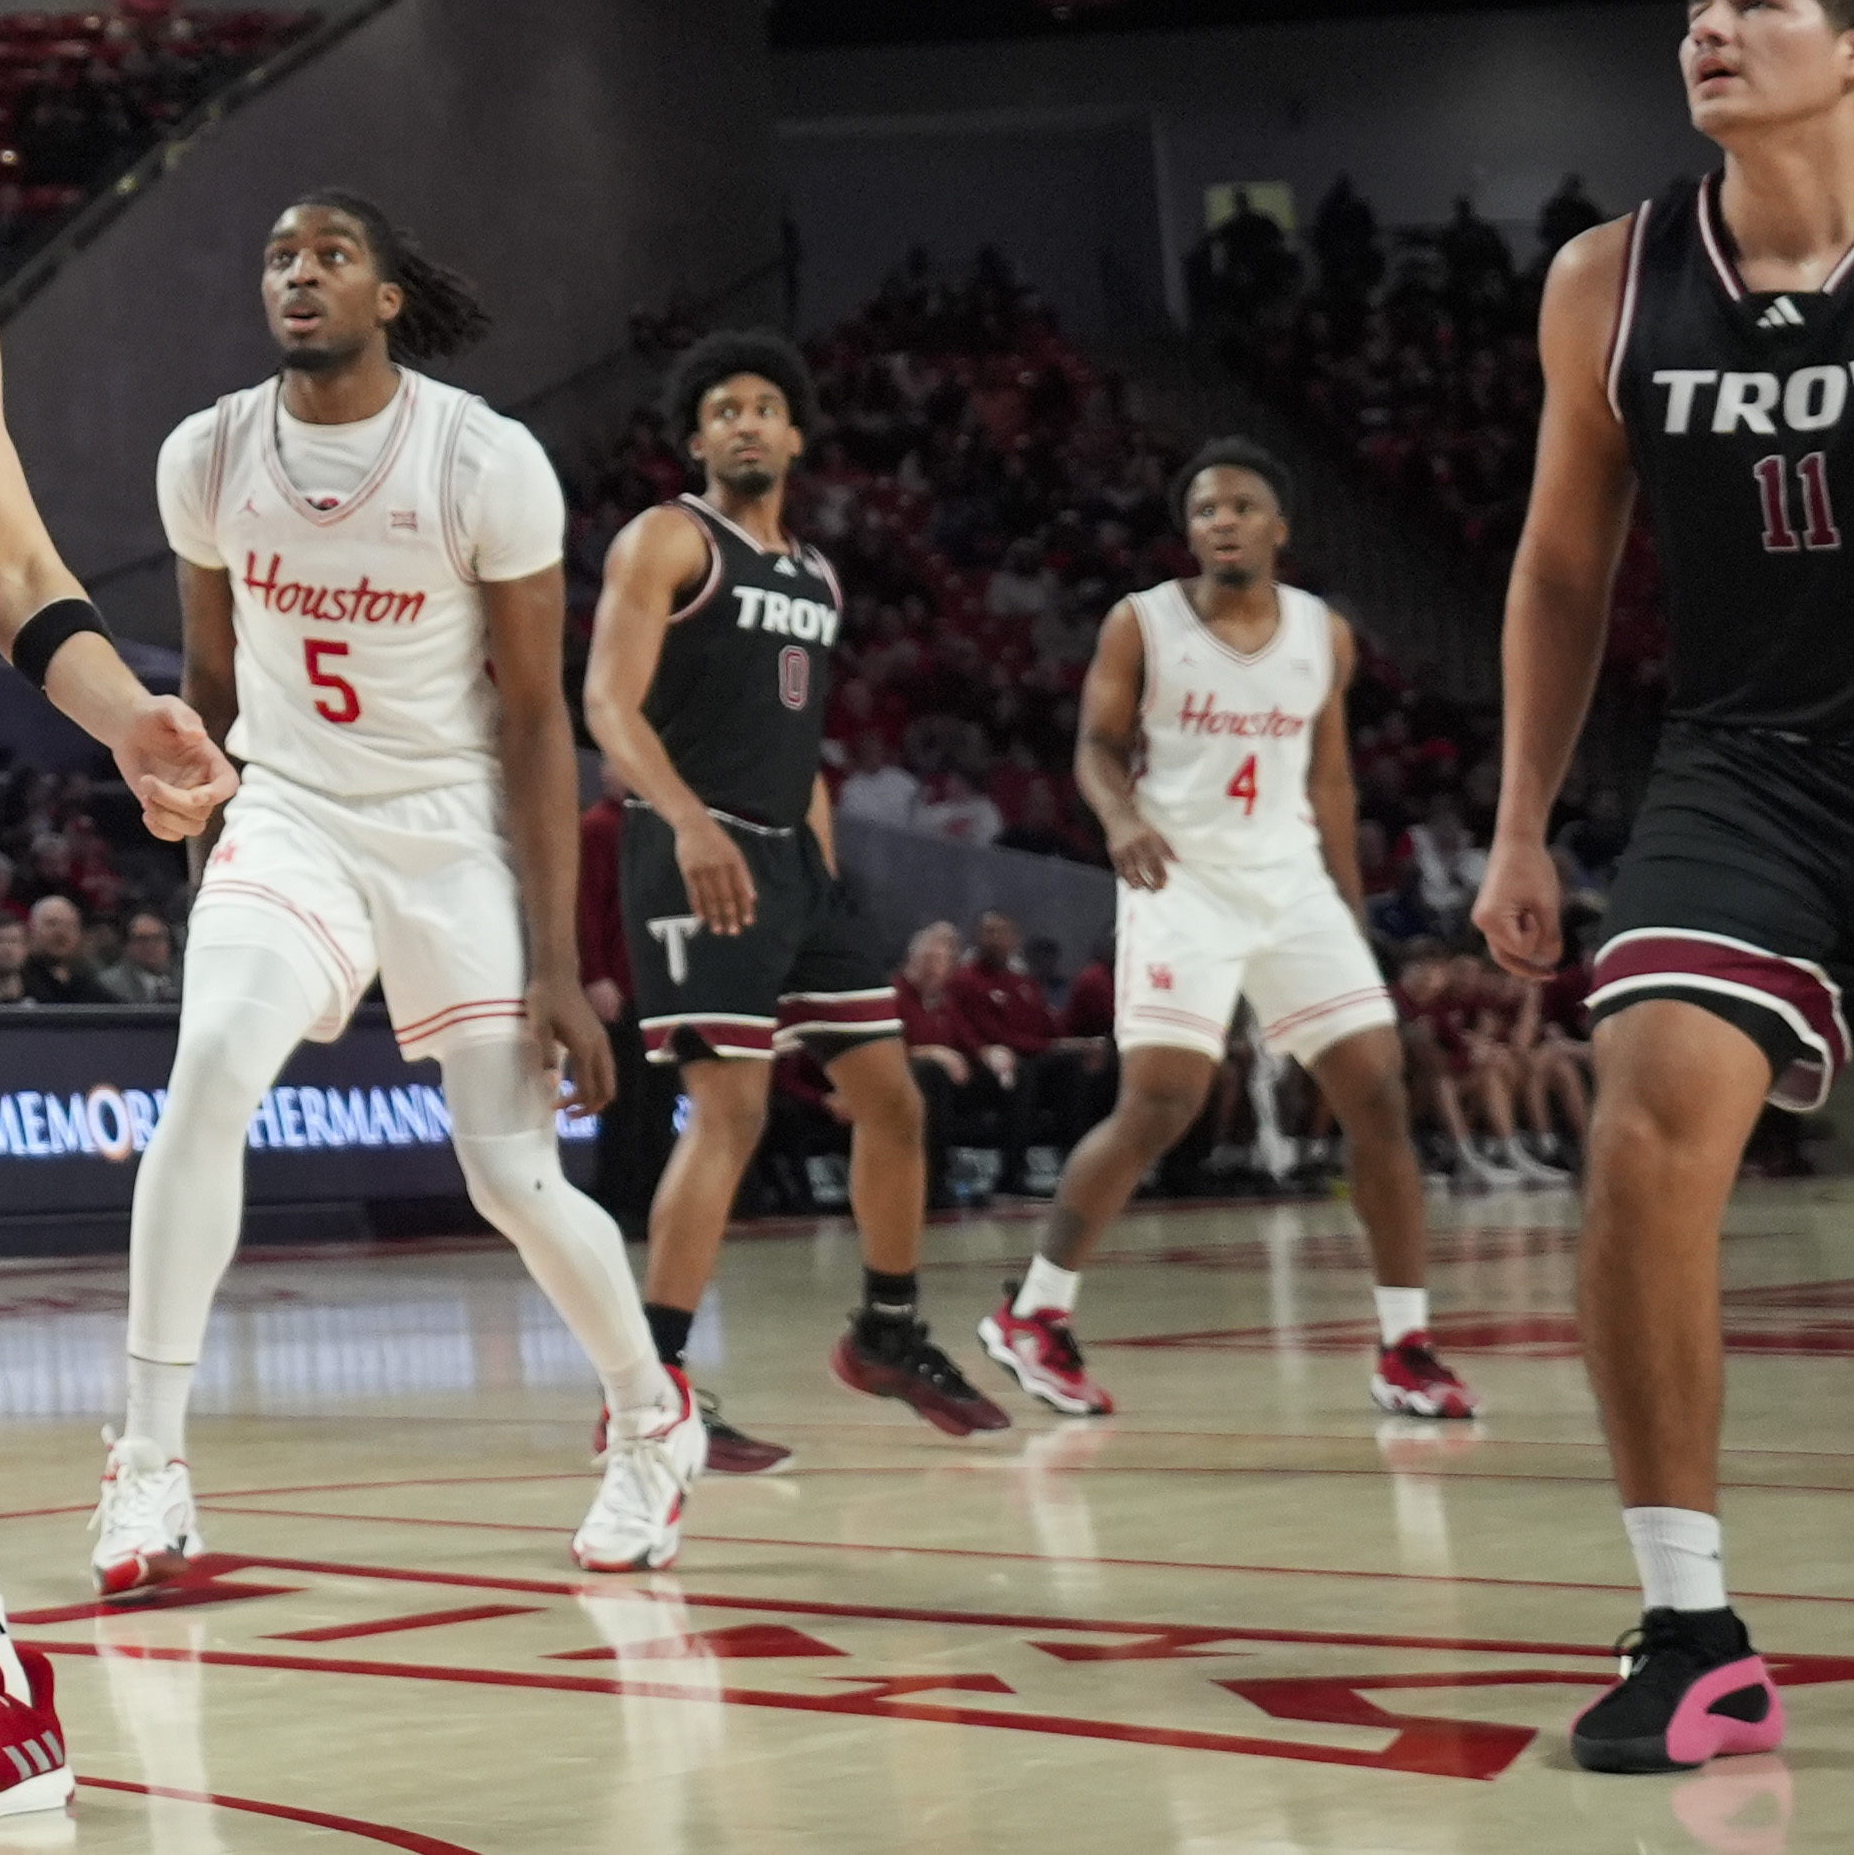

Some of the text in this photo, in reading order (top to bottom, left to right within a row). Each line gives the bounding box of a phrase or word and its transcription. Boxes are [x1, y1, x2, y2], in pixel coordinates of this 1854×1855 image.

[1651, 360, 1854, 435] TRO
[1753, 451, 1842, 553] 11
[243, 550, 426, 625] Houston
[731, 585, 838, 647] TROY
[303, 638, 362, 723] 5
[778, 645, 810, 712] 0
[1225, 752, 1258, 817] 4
